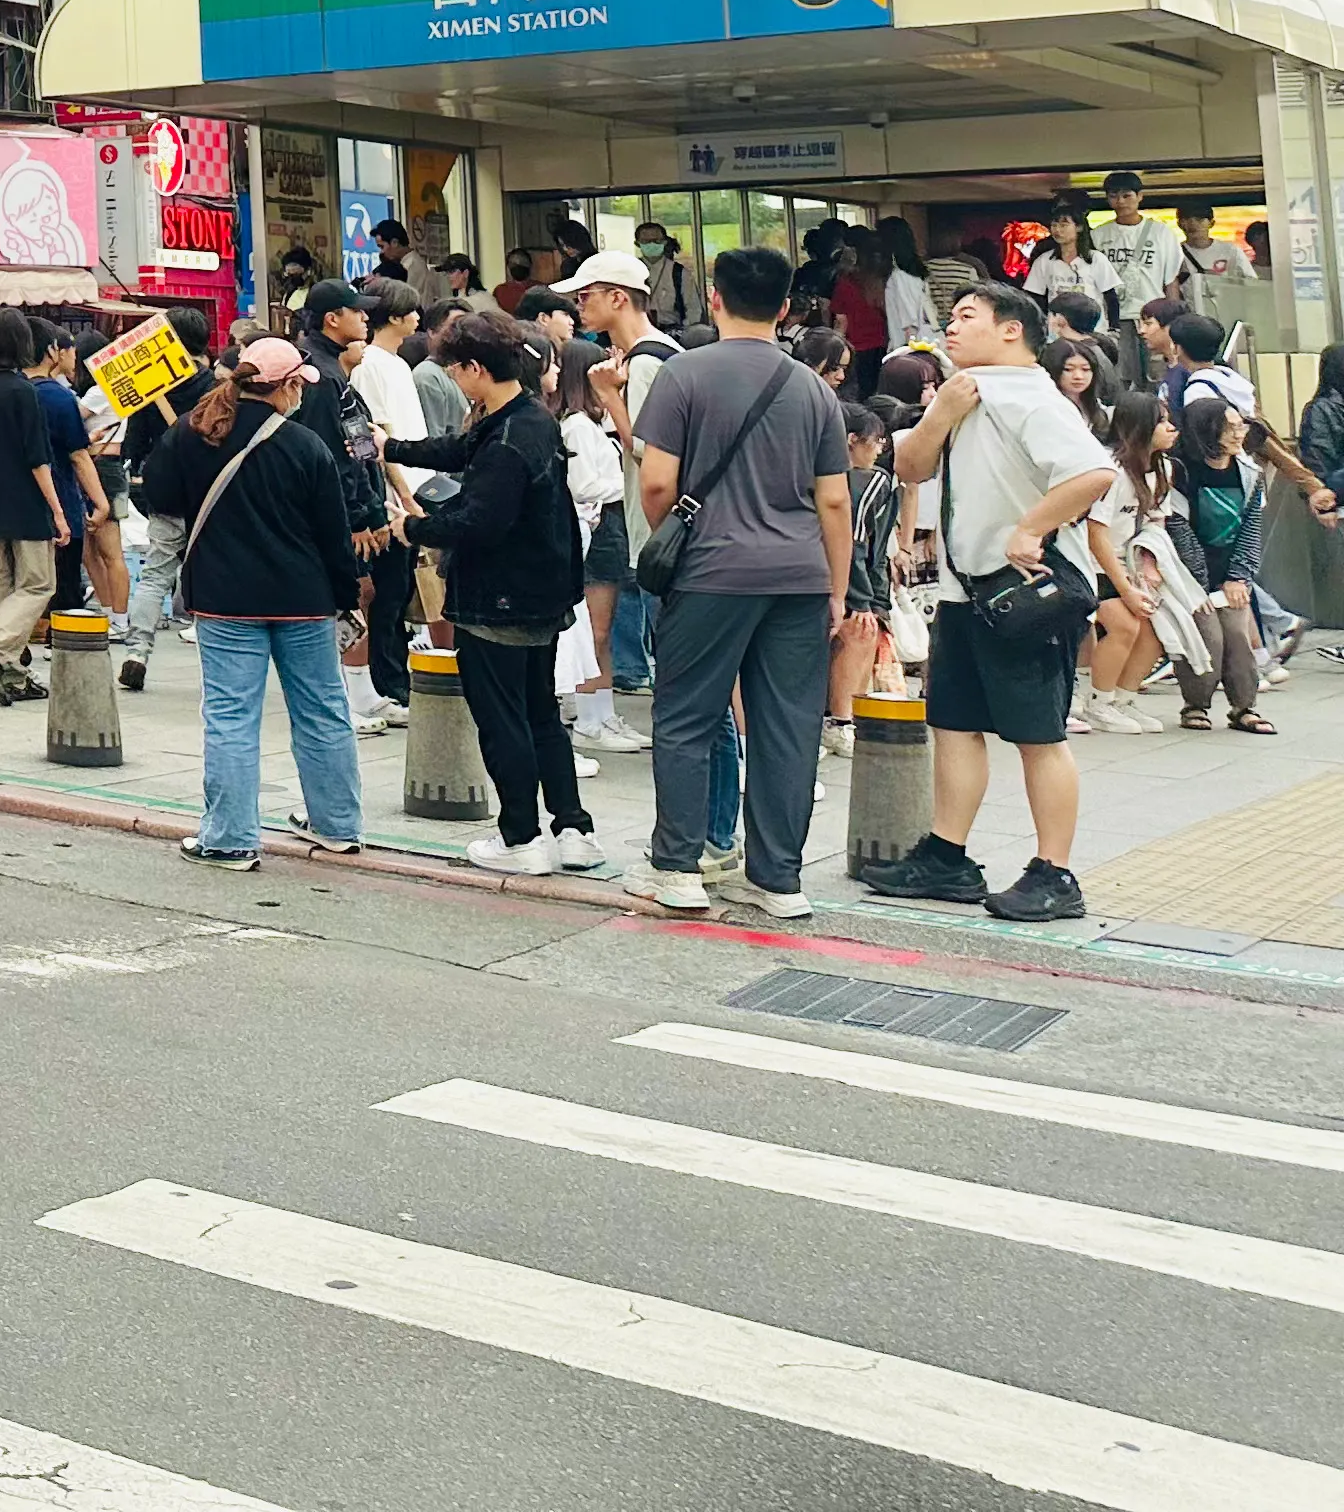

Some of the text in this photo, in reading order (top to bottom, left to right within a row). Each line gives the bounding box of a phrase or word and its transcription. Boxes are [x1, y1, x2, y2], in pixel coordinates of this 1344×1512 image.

[427, 5, 609, 40] XIMEN STATION
[162, 205, 235, 259] STONE
